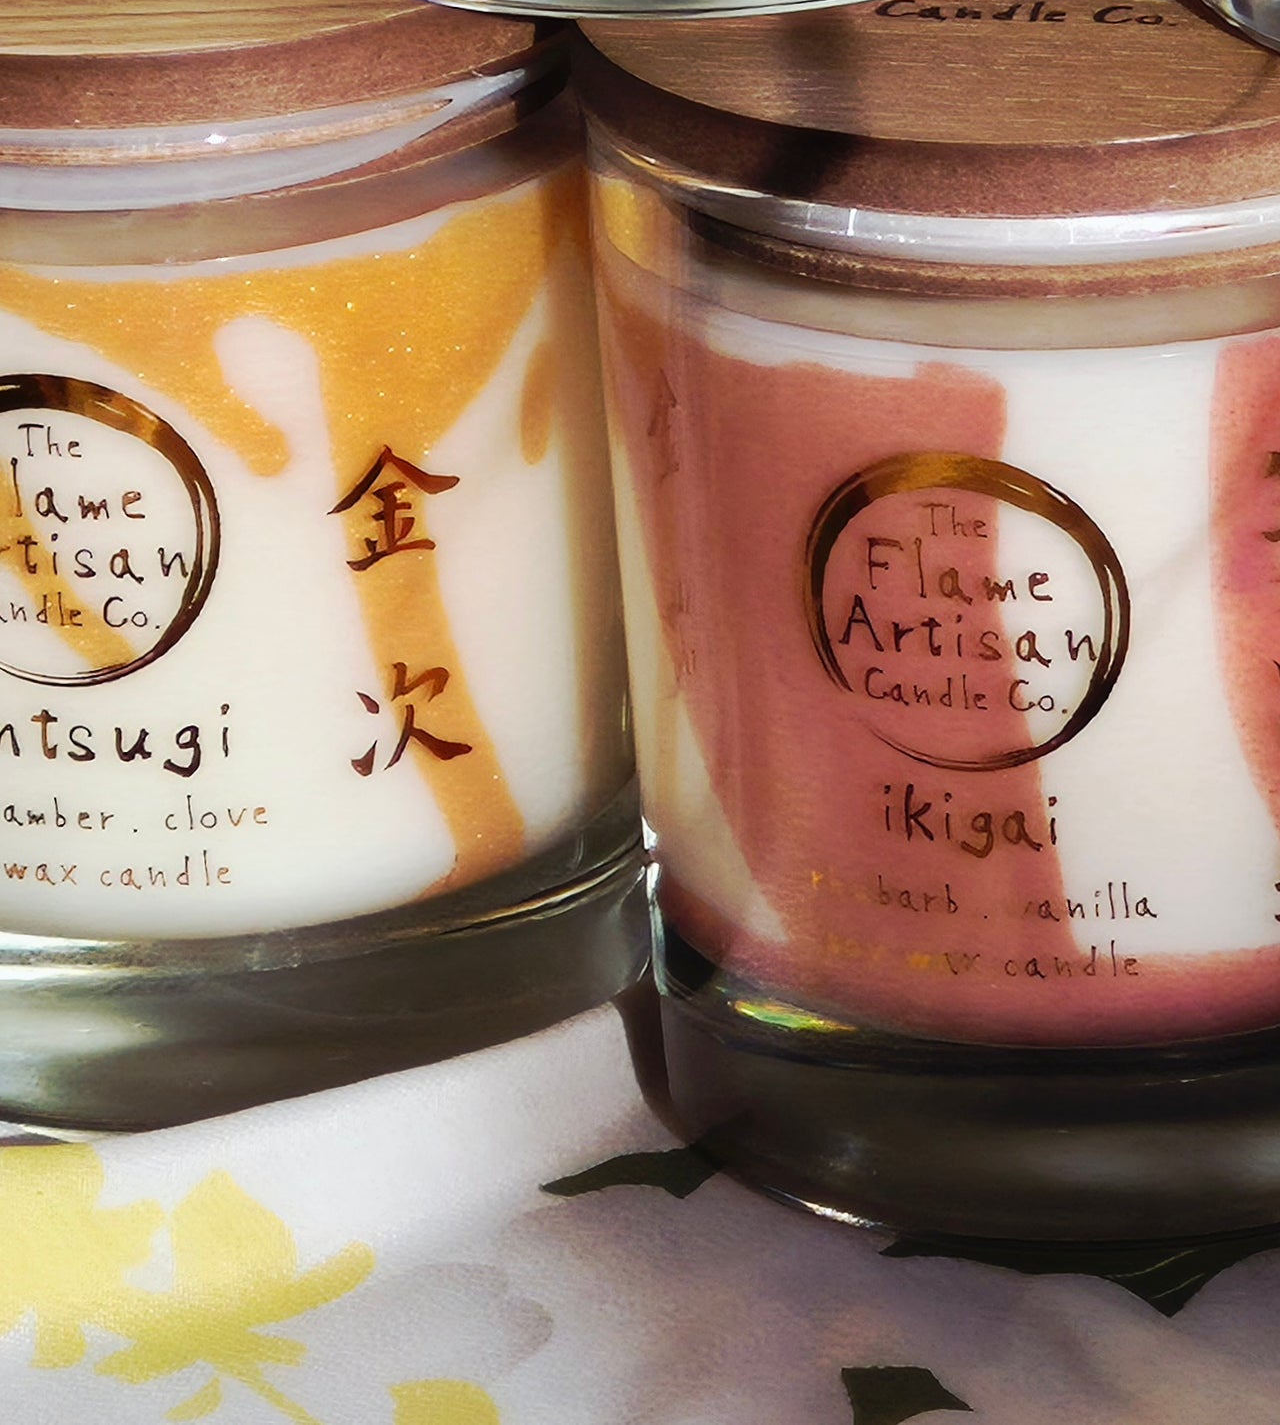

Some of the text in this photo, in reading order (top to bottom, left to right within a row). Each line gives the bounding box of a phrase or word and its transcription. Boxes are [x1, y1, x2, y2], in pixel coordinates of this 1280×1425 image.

[18, 423, 83, 461] The
[920, 502, 989, 540] The
[865, 536, 1054, 605] Flame
[101, 595, 162, 631] Co.
[326, 443, 474, 777] 金次
[838, 594, 1099, 668] Artisan
[863, 667, 1069, 716] Candle Co.
[2, 796, 116, 832] amber
[164, 794, 270, 832] clove
[881, 783, 1060, 859] ikigai
[3, 860, 78, 887] wax
[100, 850, 233, 890] candle
[1004, 939, 1140, 979] candle
